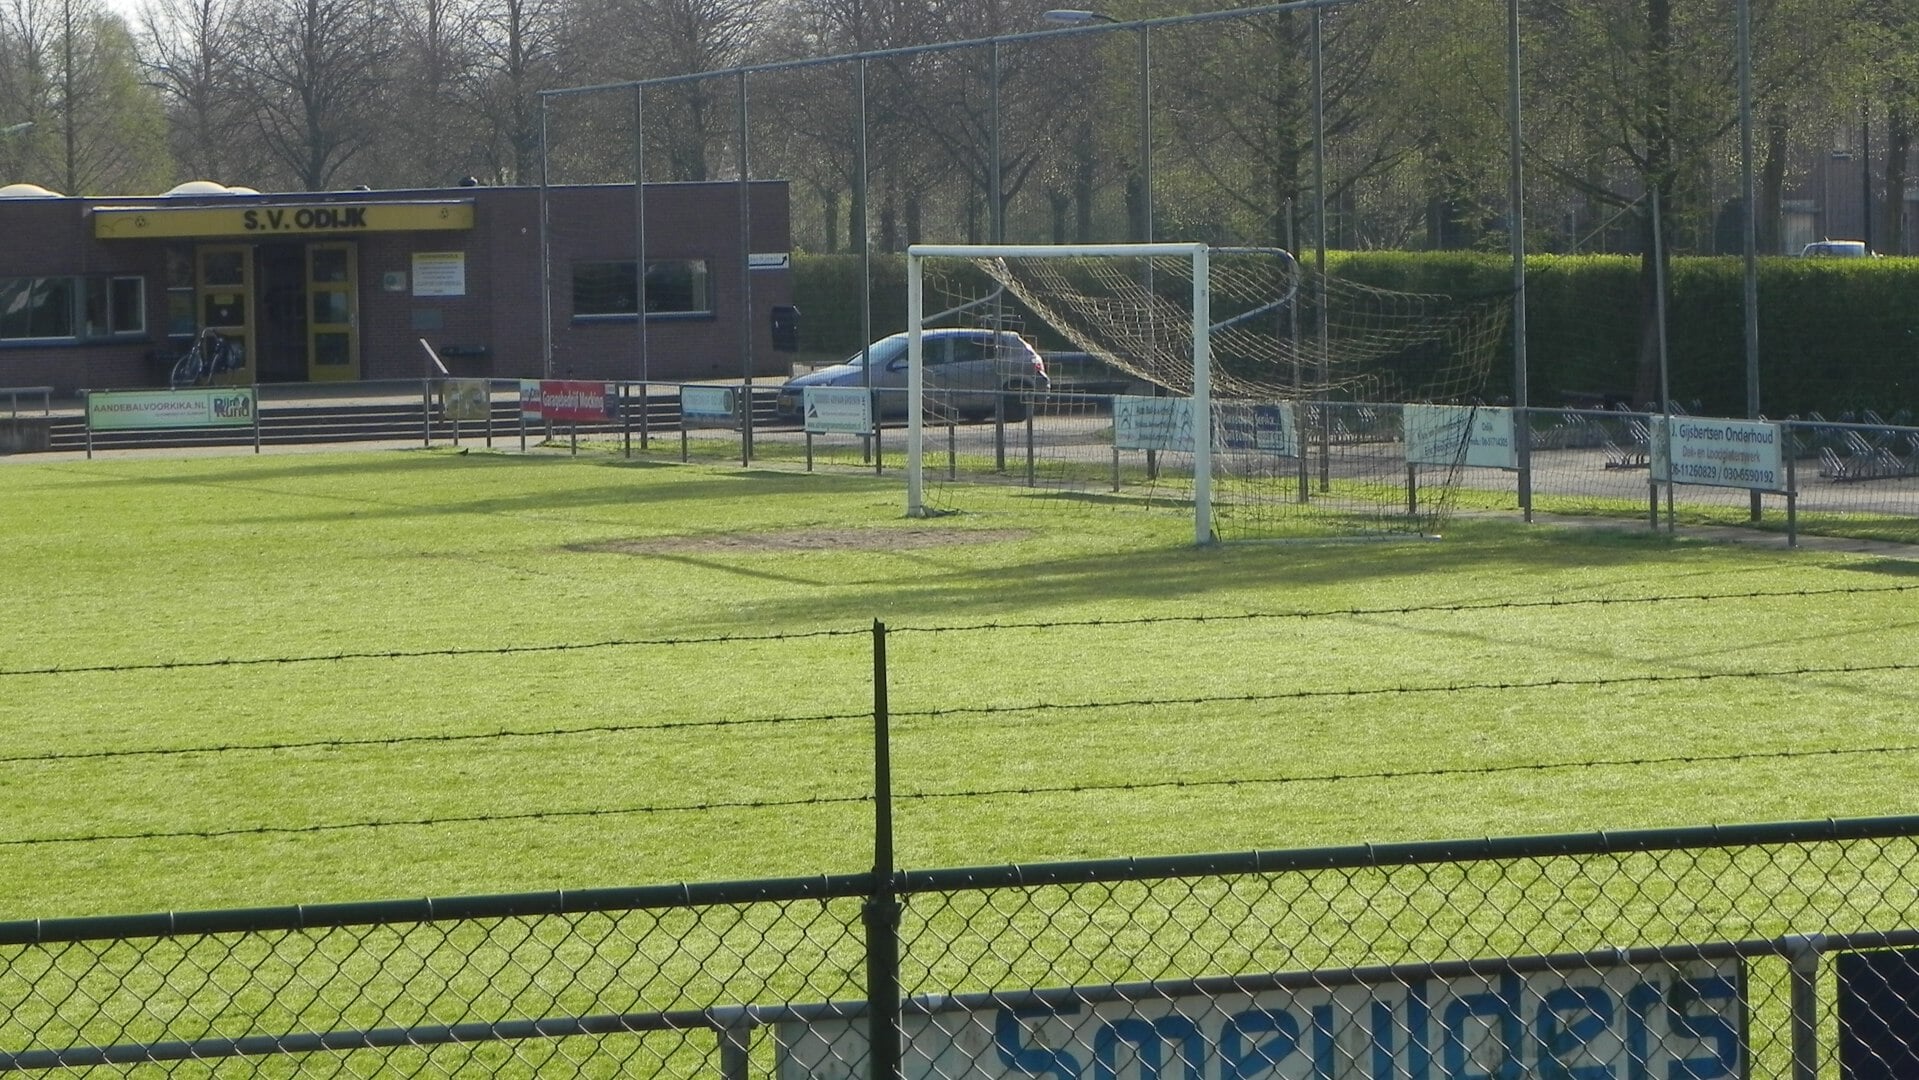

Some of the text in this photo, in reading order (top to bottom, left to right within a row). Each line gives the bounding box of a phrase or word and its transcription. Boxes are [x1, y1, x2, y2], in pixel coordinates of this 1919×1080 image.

[244, 207, 367, 230] S.V. ODIJK
[1680, 424, 1724, 442] Gijsbertsen
[1725, 427, 1774, 444] Onderhoud
[1723, 467, 1774, 483] 030-6590192
[995, 966, 1739, 1080] Smeulders
